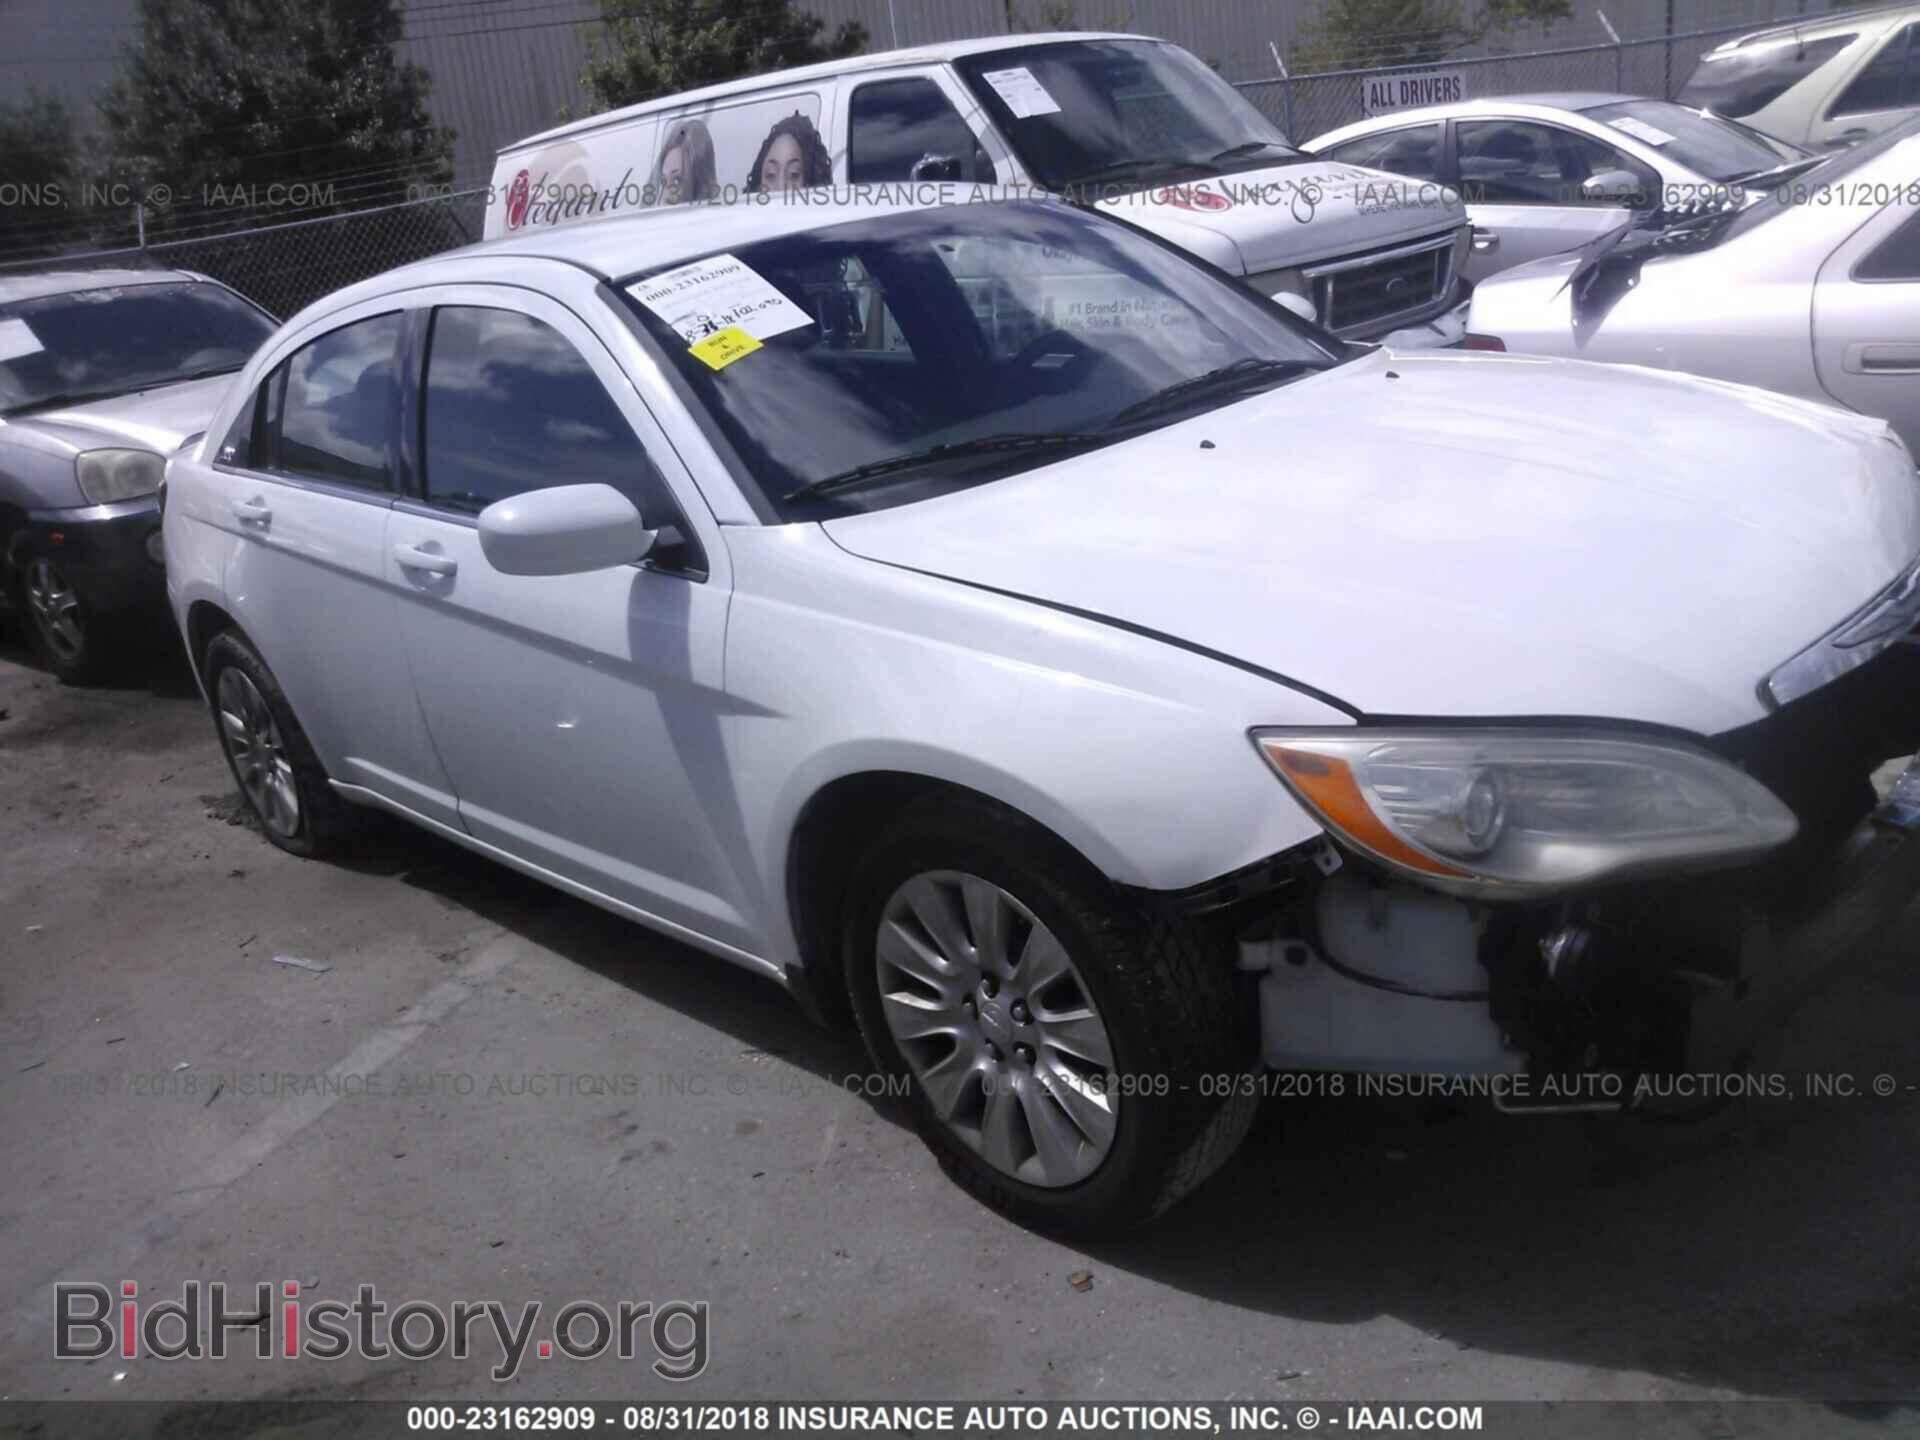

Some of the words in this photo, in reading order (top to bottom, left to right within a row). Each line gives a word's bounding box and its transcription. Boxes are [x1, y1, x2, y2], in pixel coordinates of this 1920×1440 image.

[1370, 82, 1396, 109] ALL
[1400, 76, 1461, 106] DRIVERS
[1085, 300, 1118, 314] Brand
